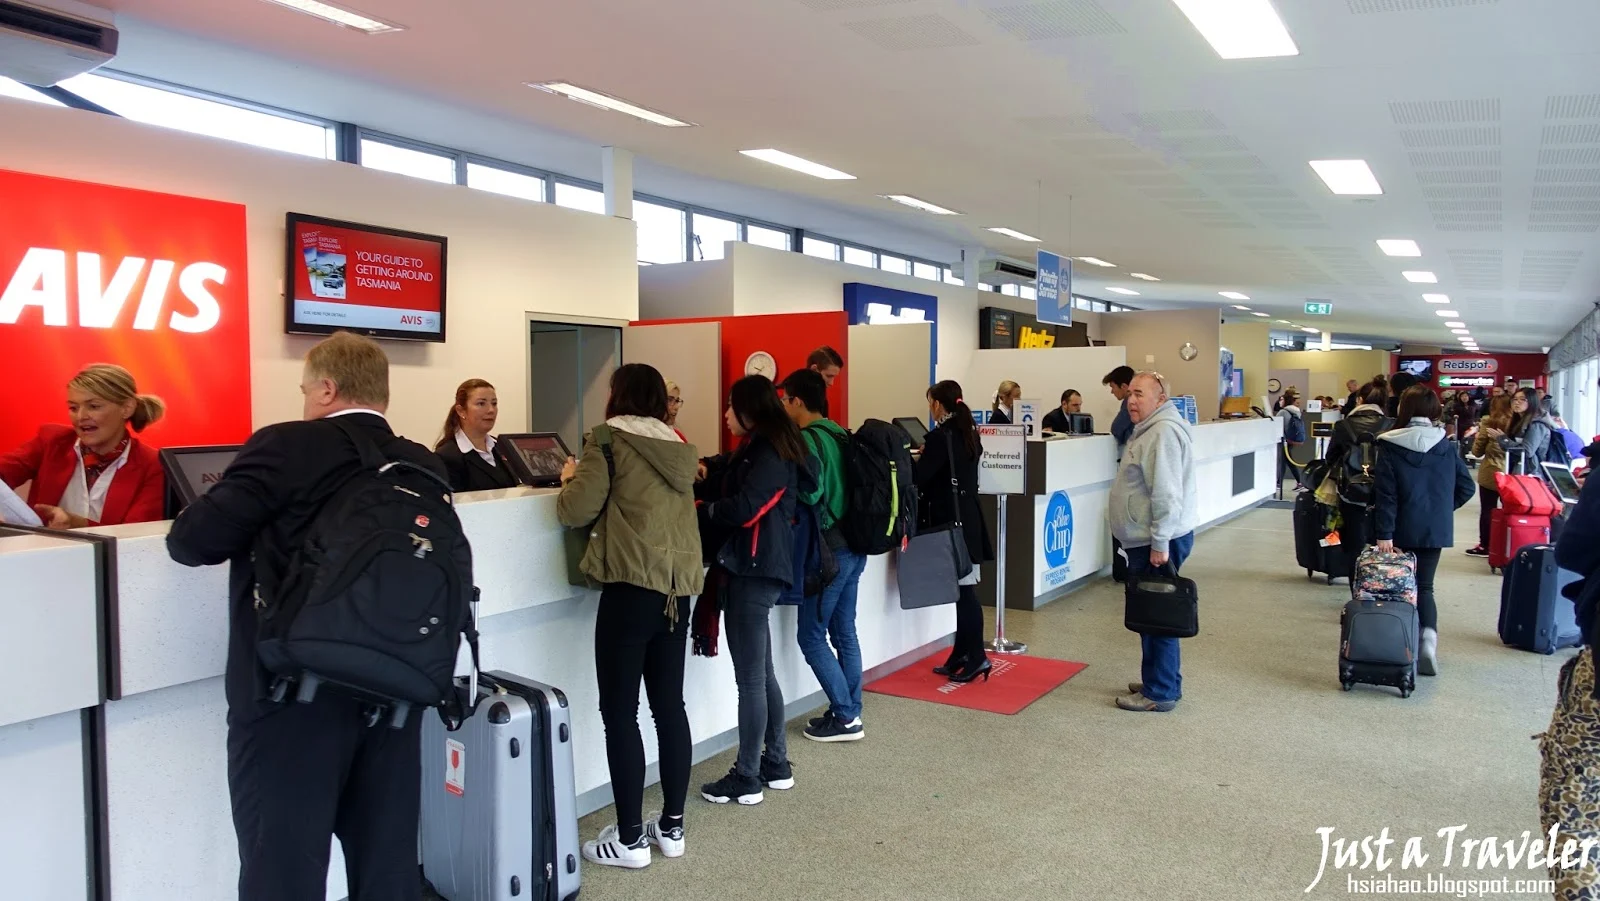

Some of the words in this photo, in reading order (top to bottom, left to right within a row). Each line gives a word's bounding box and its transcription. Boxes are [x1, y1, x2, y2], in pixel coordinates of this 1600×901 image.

[355, 250, 382, 264] YOUR
[382, 253, 410, 267] GUIDE
[409, 257, 424, 269] TO
[355, 263, 395, 278] GETTING
[395, 268, 434, 282] AROUND
[0, 246, 227, 334] AVIS
[355, 276, 402, 292] TASMANIA
[400, 314, 423, 326] AVIS
[1018, 325, 1056, 350] Hertz
[983, 451, 1021, 460] Preferred
[981, 461, 1022, 471] Customers
[1053, 505, 1070, 529] Blue
[1044, 521, 1071, 559] Chip
[936, 681, 967, 695] AVI
